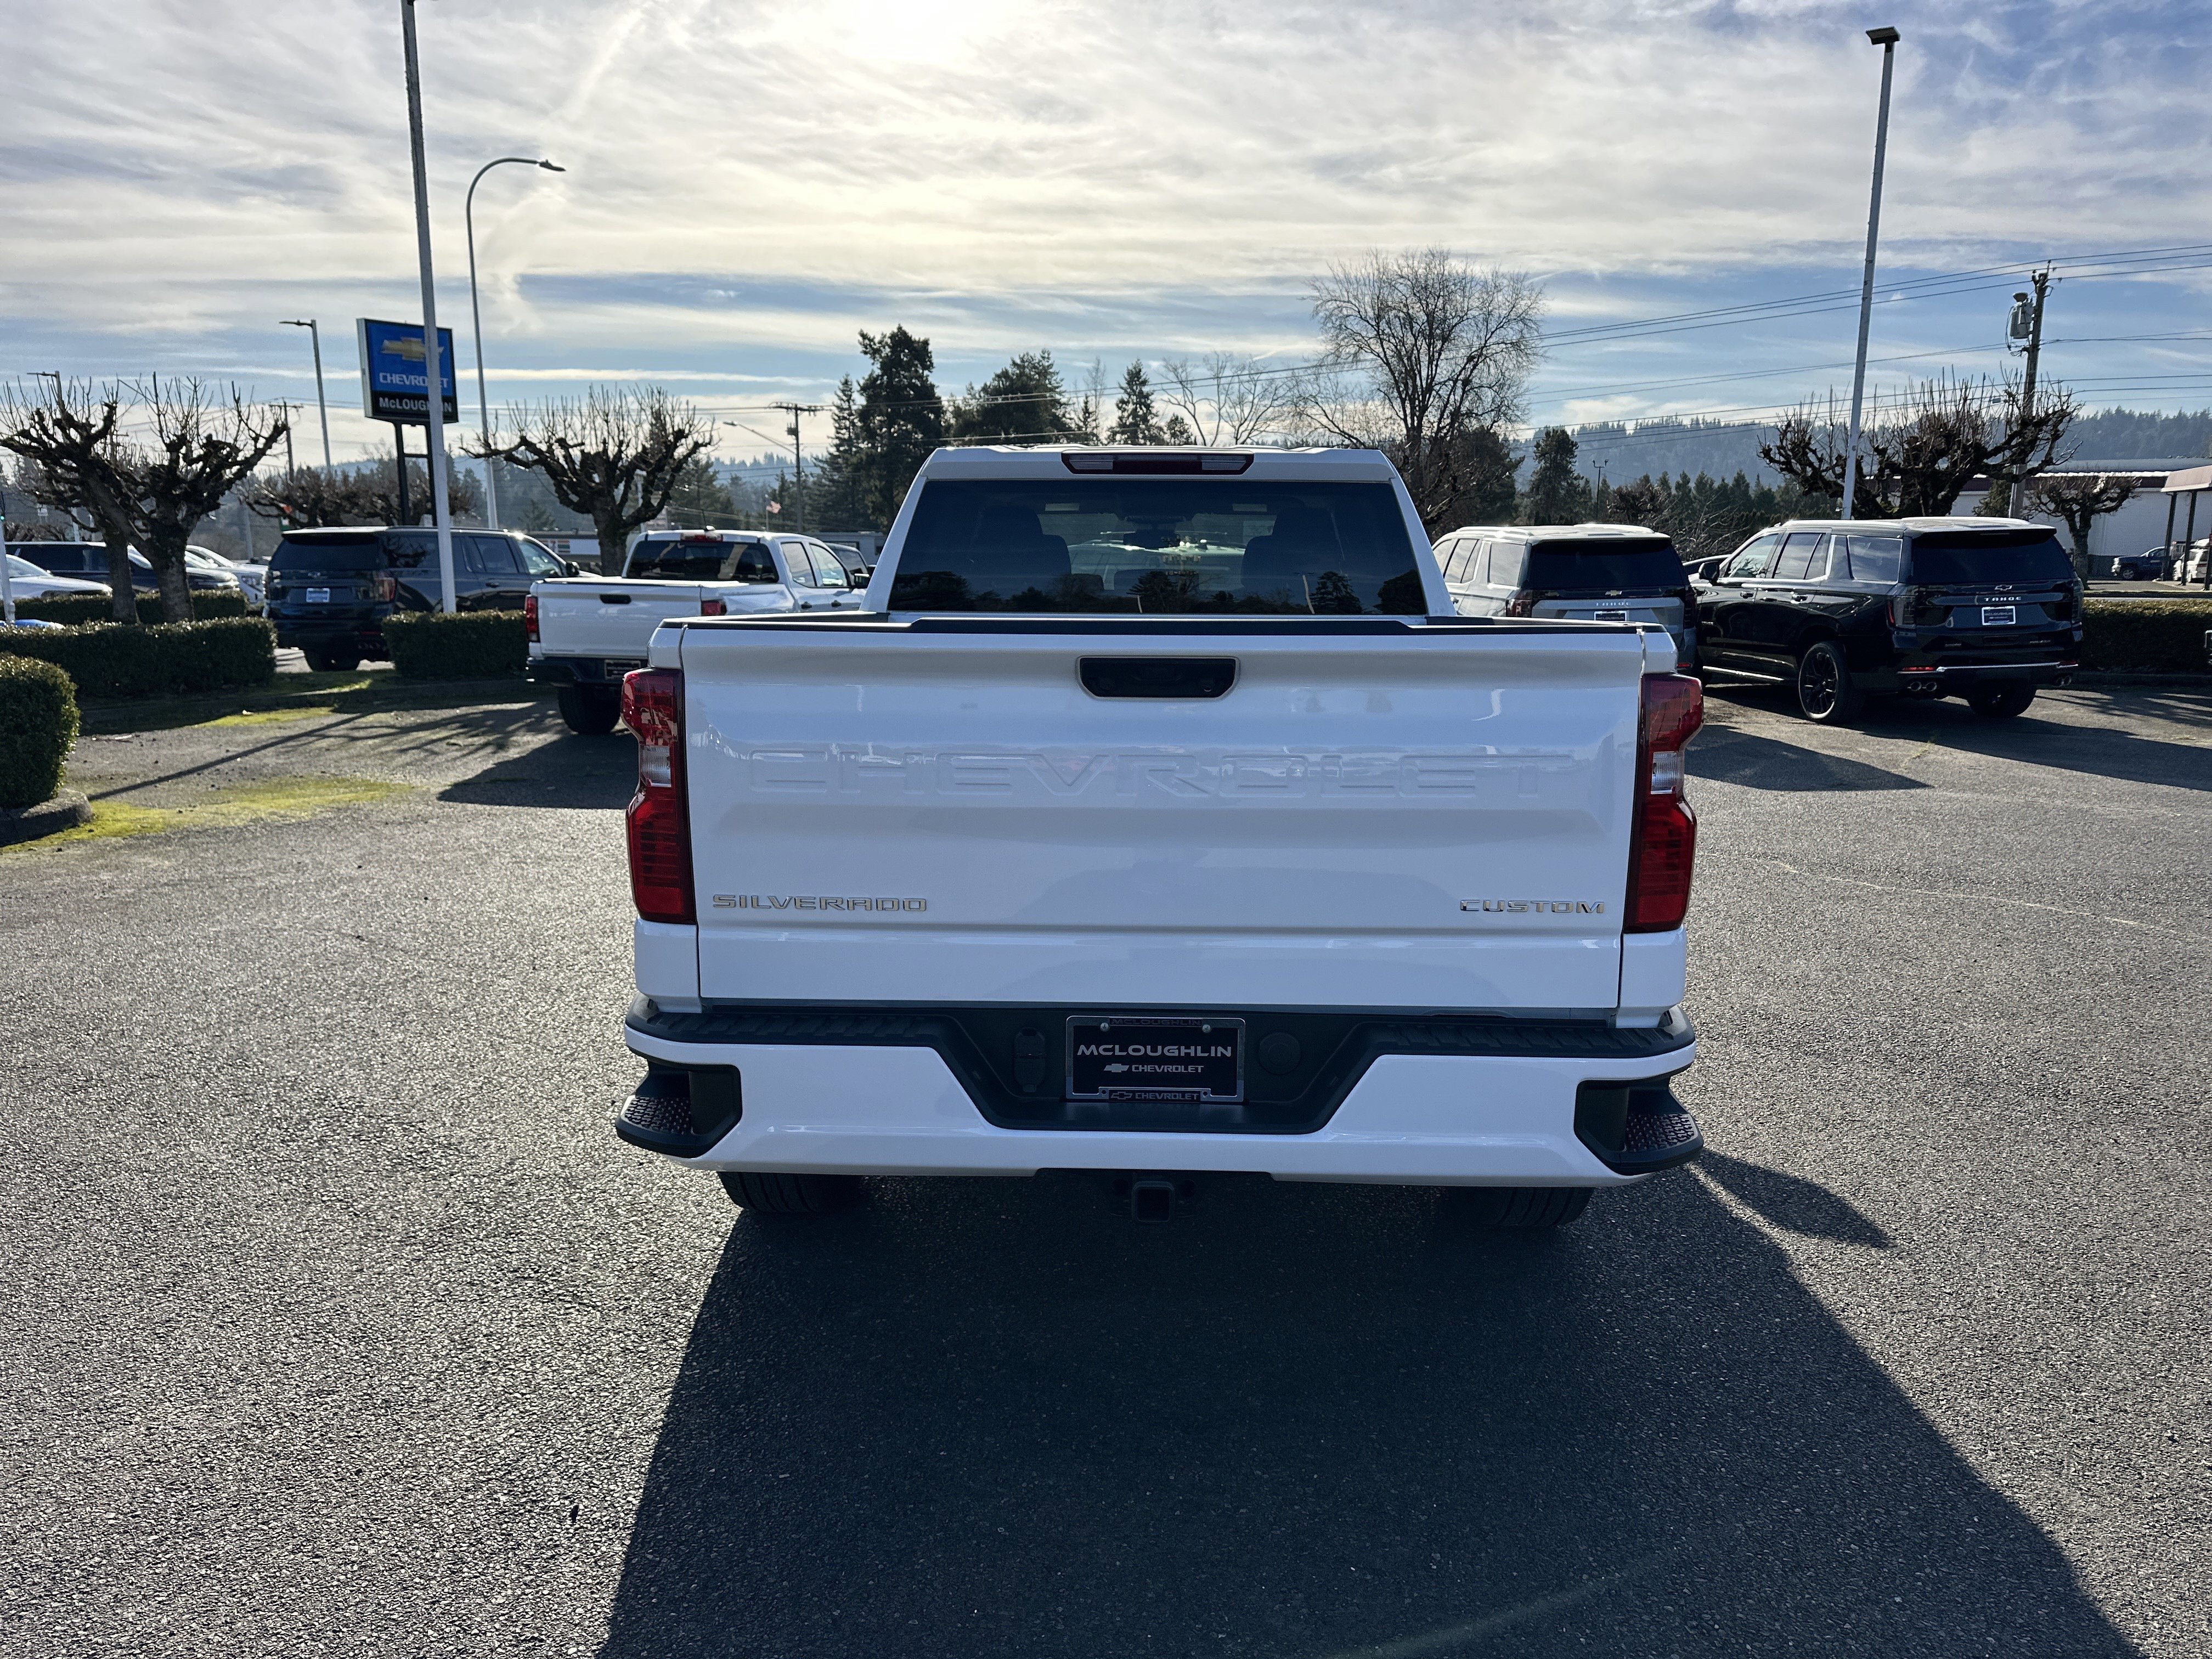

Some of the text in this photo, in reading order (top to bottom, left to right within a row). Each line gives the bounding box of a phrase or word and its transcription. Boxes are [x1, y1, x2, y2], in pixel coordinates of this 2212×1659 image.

[379, 373, 448, 388] CHEVROT
[379, 397, 452, 413] McLOUGN
[749, 749, 1574, 797] CHEVROLET
[712, 894, 927, 912] SILVERADO
[1459, 899, 1605, 914] CUSTOM
[1077, 1045, 1232, 1057] MCLOUGHLIN
[1132, 1064, 1204, 1073] CHEVROLET
[1135, 1092, 1199, 1101] CHEVROLET
